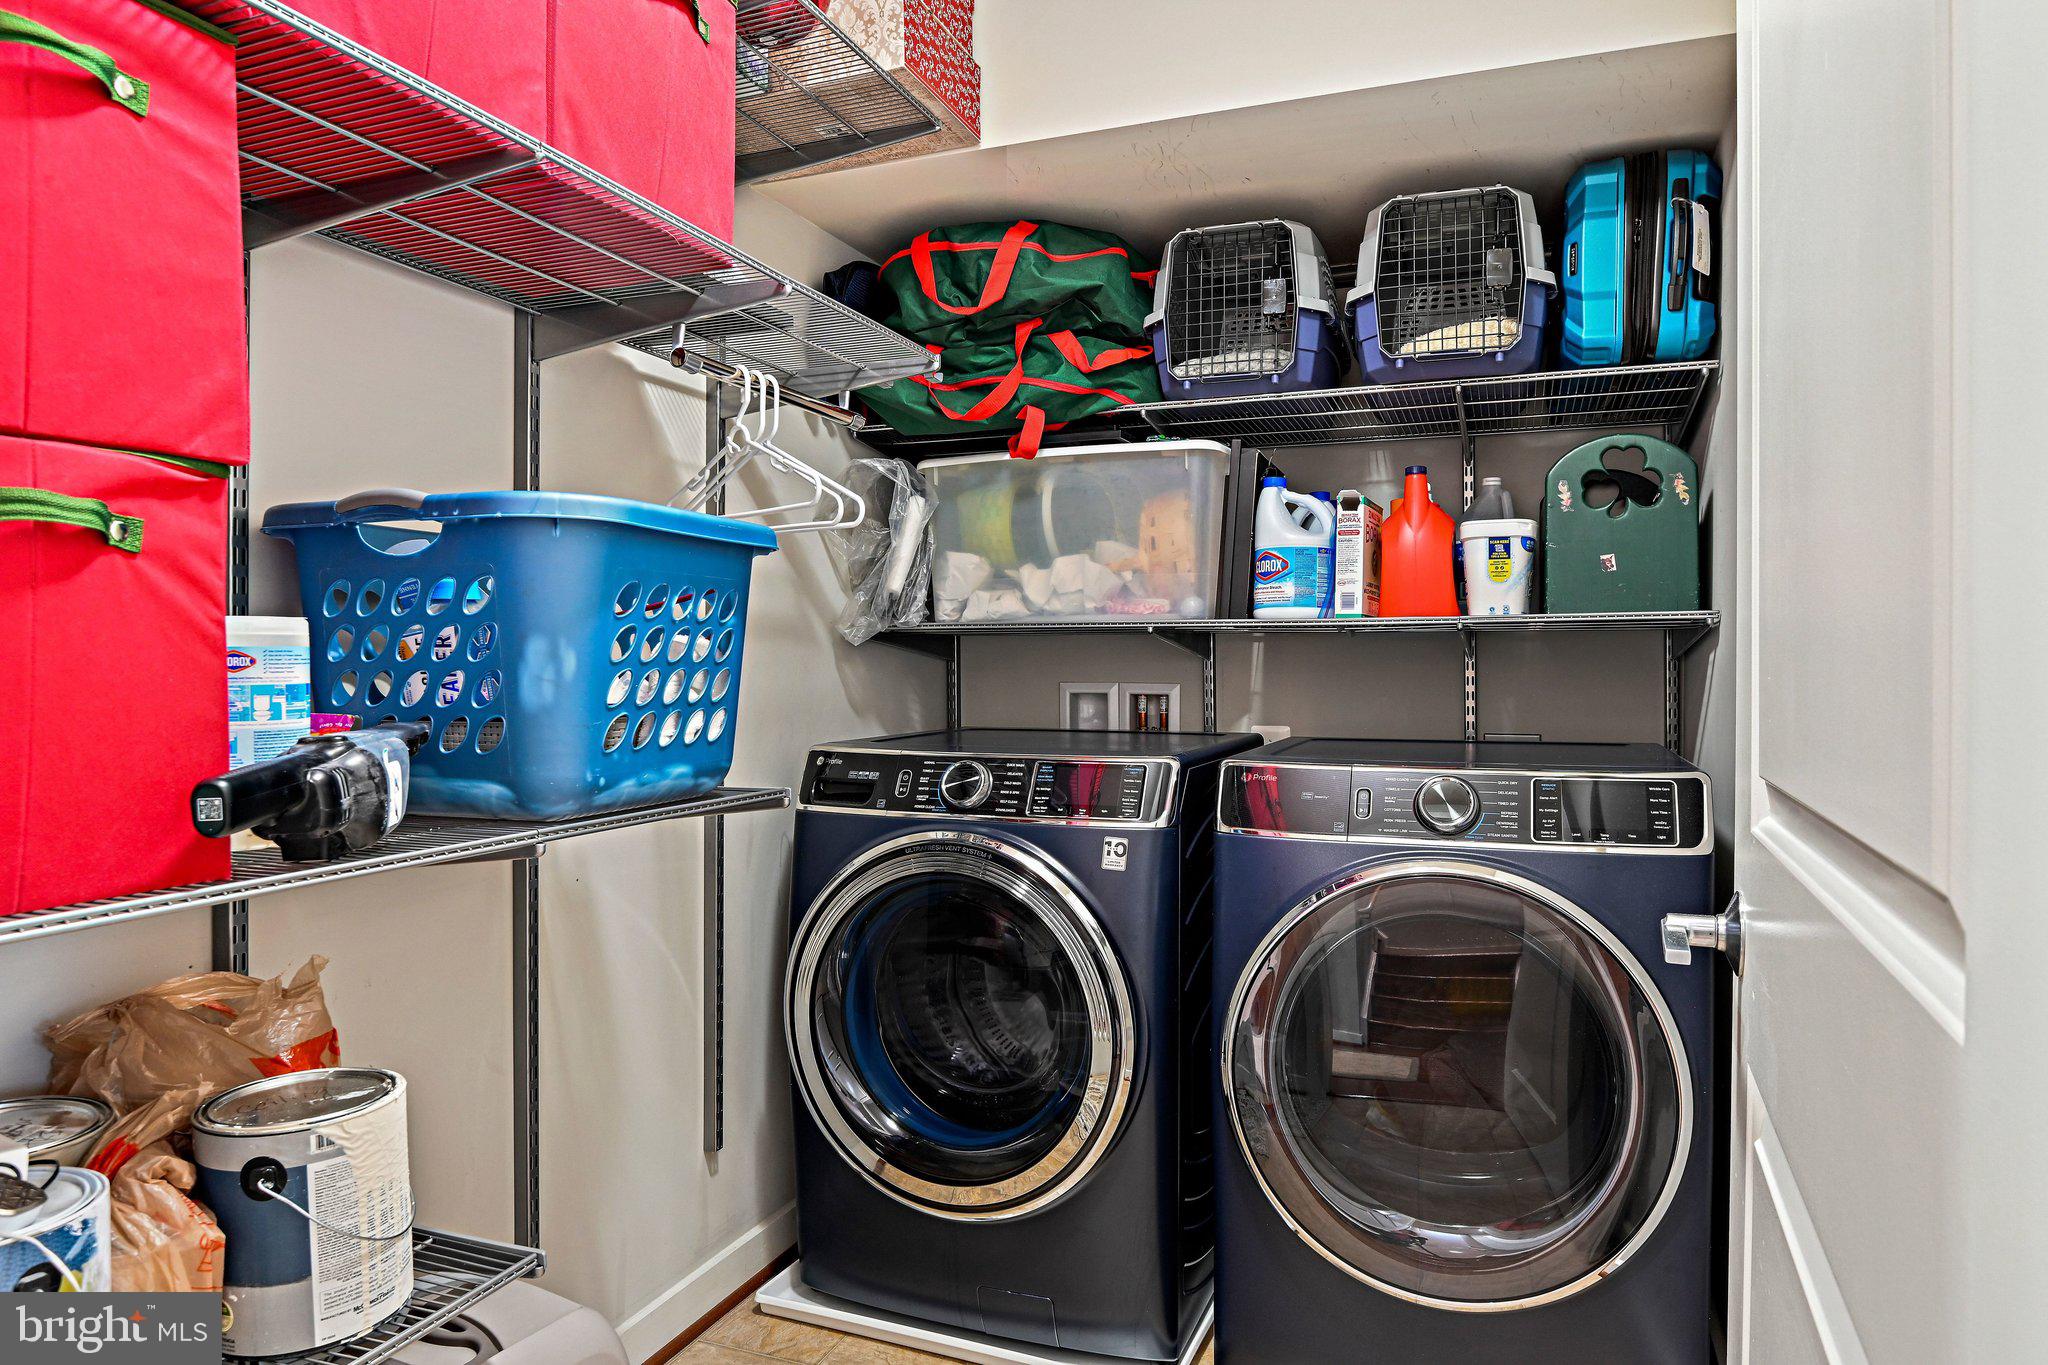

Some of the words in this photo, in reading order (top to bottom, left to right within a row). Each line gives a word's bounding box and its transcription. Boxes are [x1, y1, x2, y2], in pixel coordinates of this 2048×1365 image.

[1256, 560, 1282, 573] CLOROX
[228, 656, 251, 666] OROX
[1253, 773, 1277, 781] Profile
[905, 844, 944, 854] ULTRAFRESH
[962, 845, 987, 858] SYSTEM
[1105, 841, 1127, 857] 10
